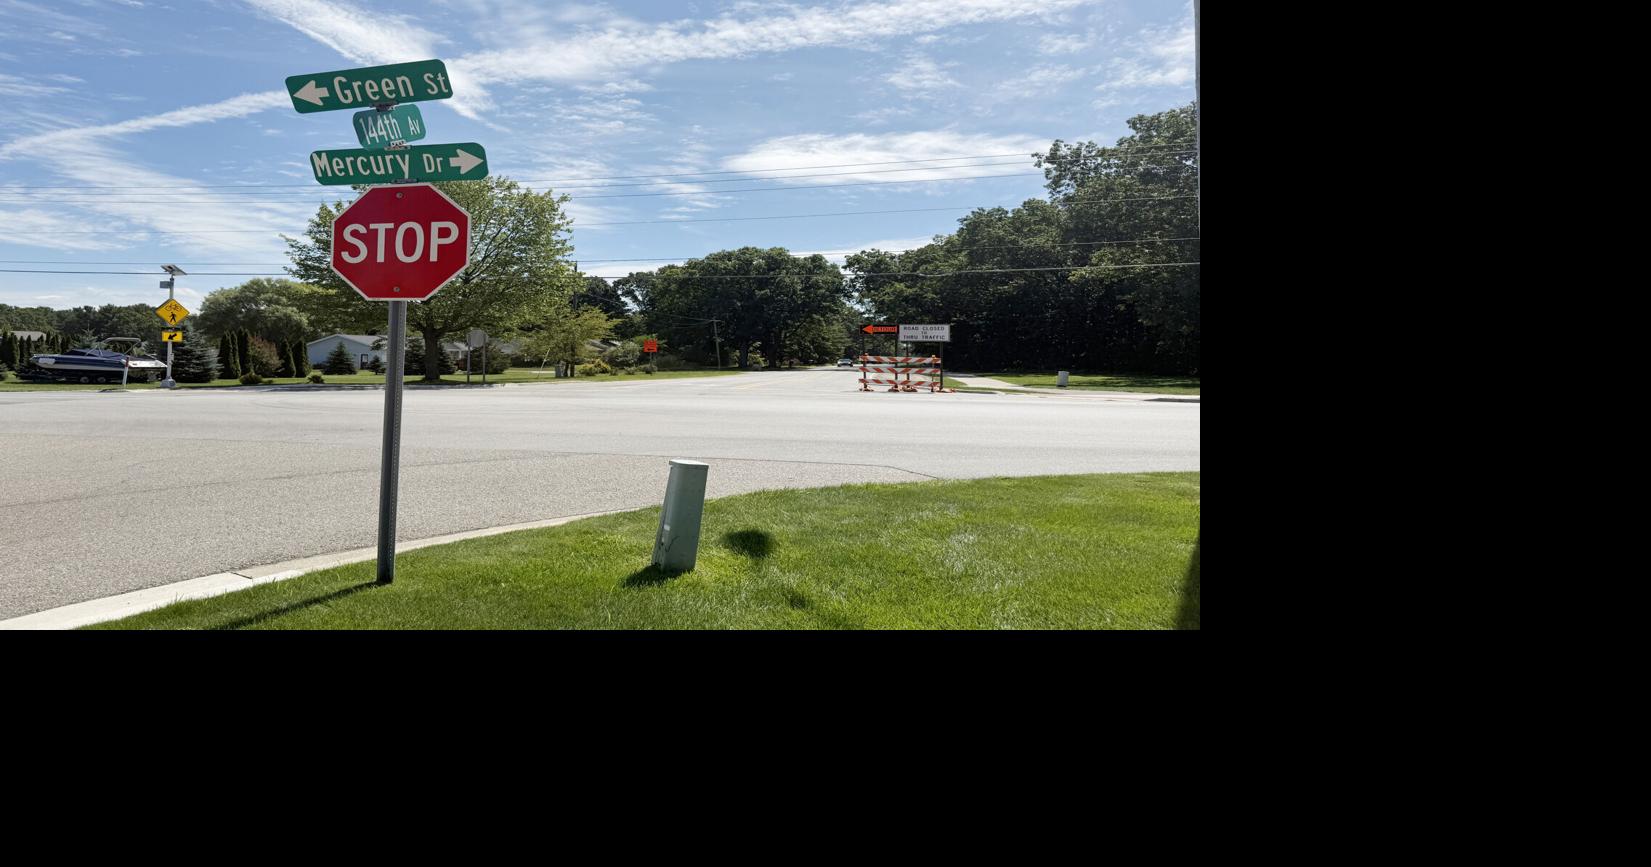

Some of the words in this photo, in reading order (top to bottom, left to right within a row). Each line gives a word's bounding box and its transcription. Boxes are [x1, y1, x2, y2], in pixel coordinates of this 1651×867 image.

[334, 75, 414, 104] Green
[423, 72, 449, 95] St
[359, 113, 402, 145] 144th
[407, 115, 421, 136] Av
[312, 153, 410, 179] Mercury
[422, 153, 444, 174] Dr
[340, 221, 460, 264] STOP
